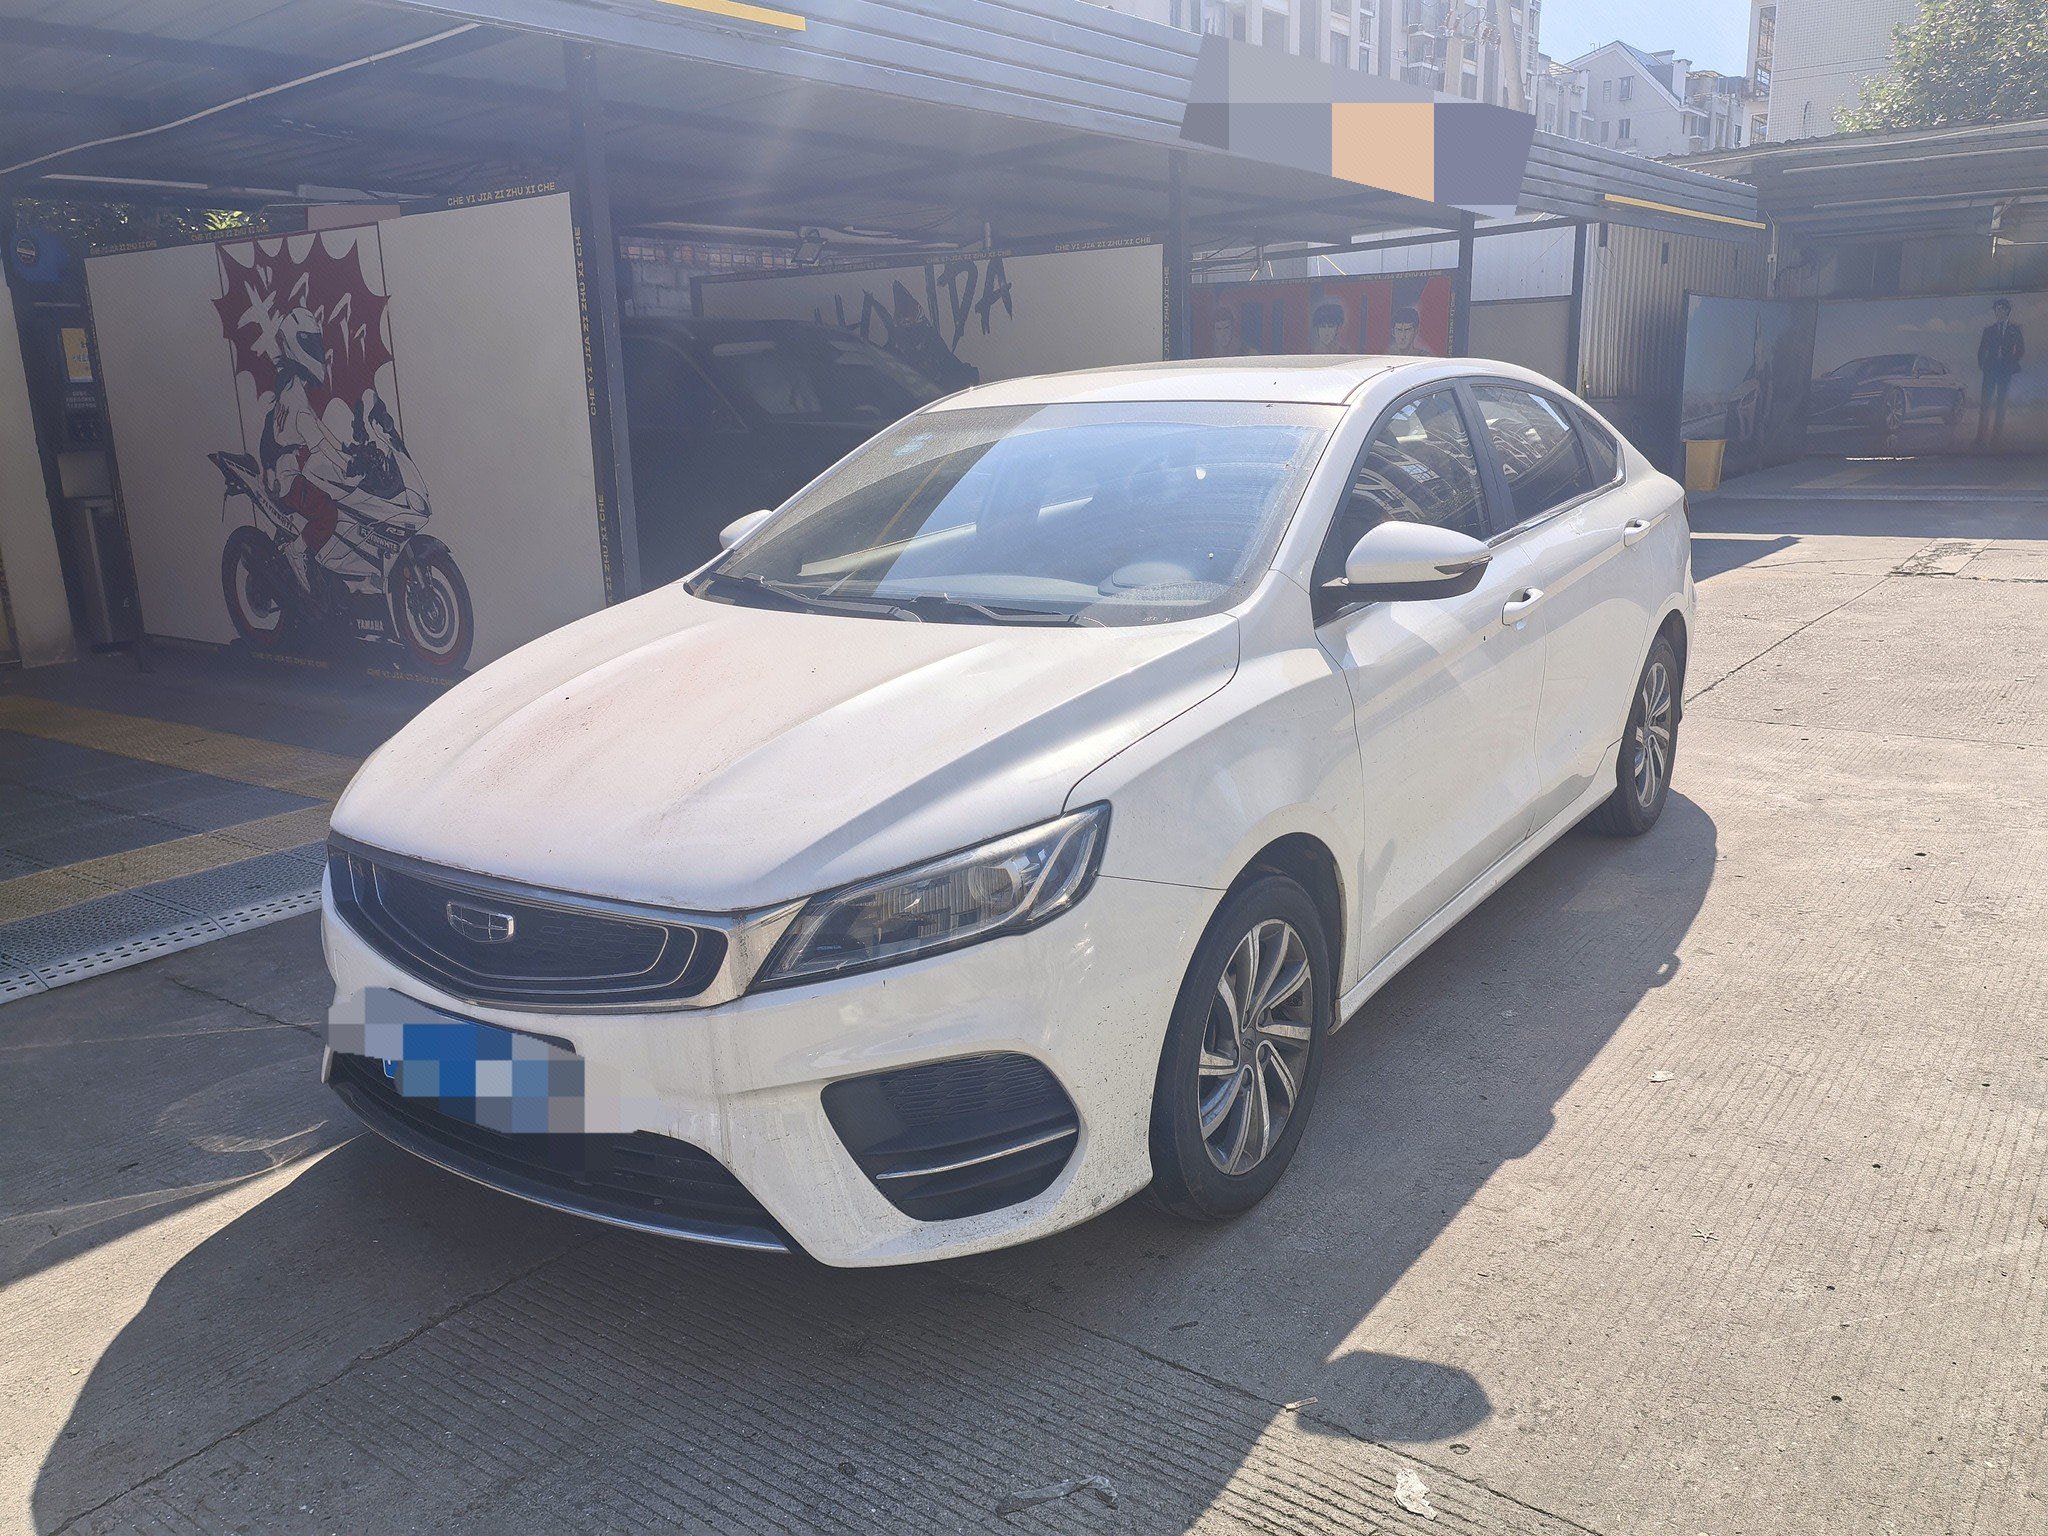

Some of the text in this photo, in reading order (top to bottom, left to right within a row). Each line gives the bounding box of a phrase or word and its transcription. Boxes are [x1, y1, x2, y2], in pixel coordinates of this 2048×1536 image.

[447, 182, 556, 206] CHE YI JIA ZI ZHU XI CHE
[1082, 241, 1096, 249] JIA
[1135, 236, 1152, 244] CHE
[574, 226, 598, 416] CHE YI JIA ZI ZHU XI CHE
[356, 618, 384, 631] YAMAHA
